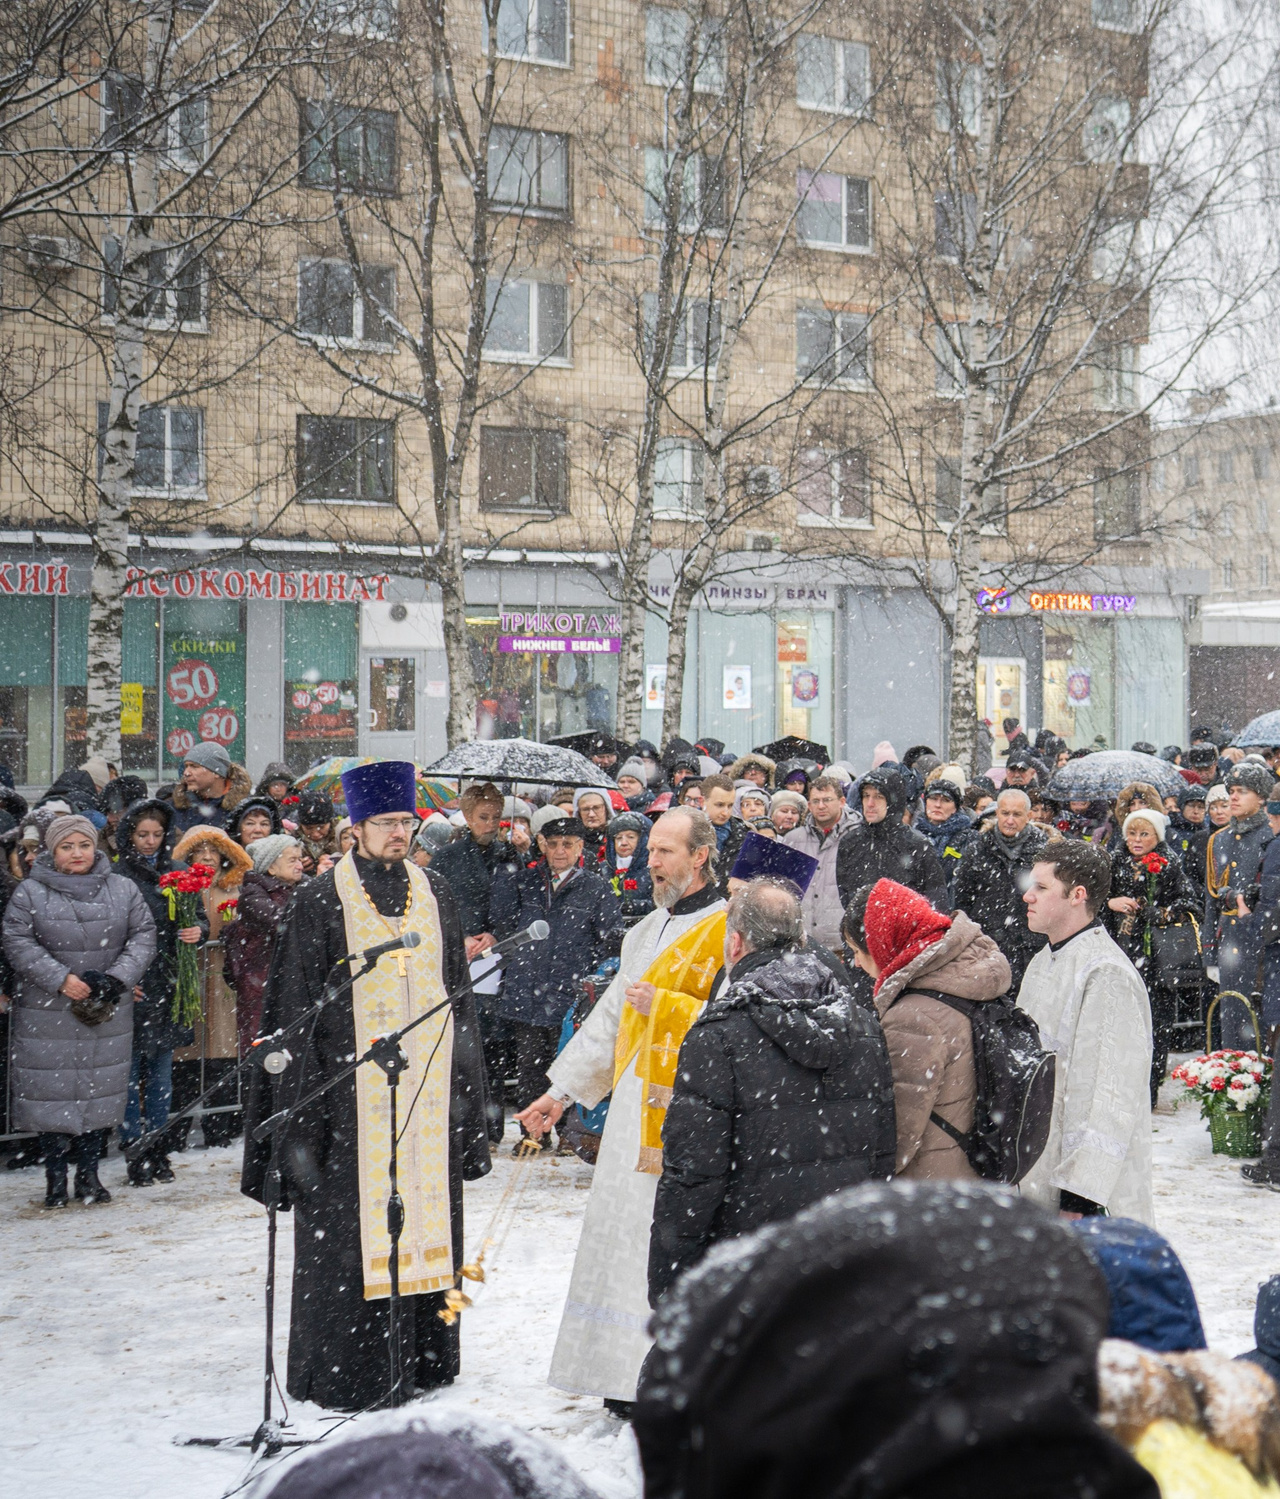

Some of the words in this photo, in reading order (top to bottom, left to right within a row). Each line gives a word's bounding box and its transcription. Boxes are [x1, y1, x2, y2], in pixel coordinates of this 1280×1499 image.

[125, 564, 391, 602] ЯСОКОМБИНАТ
[708, 586, 767, 600] ЛИНЗЫ
[499, 612, 621, 634] ТРИКОТАЖ
[172, 640, 237, 655] СКИДКИ
[512, 638, 566, 652] НИЖНЕЕ
[571, 638, 611, 652] БЕЛЬЁ
[170, 665, 217, 705] 50
[319, 685, 339, 704] 50
[201, 712, 239, 741] 30
[169, 731, 195, 754] 20
